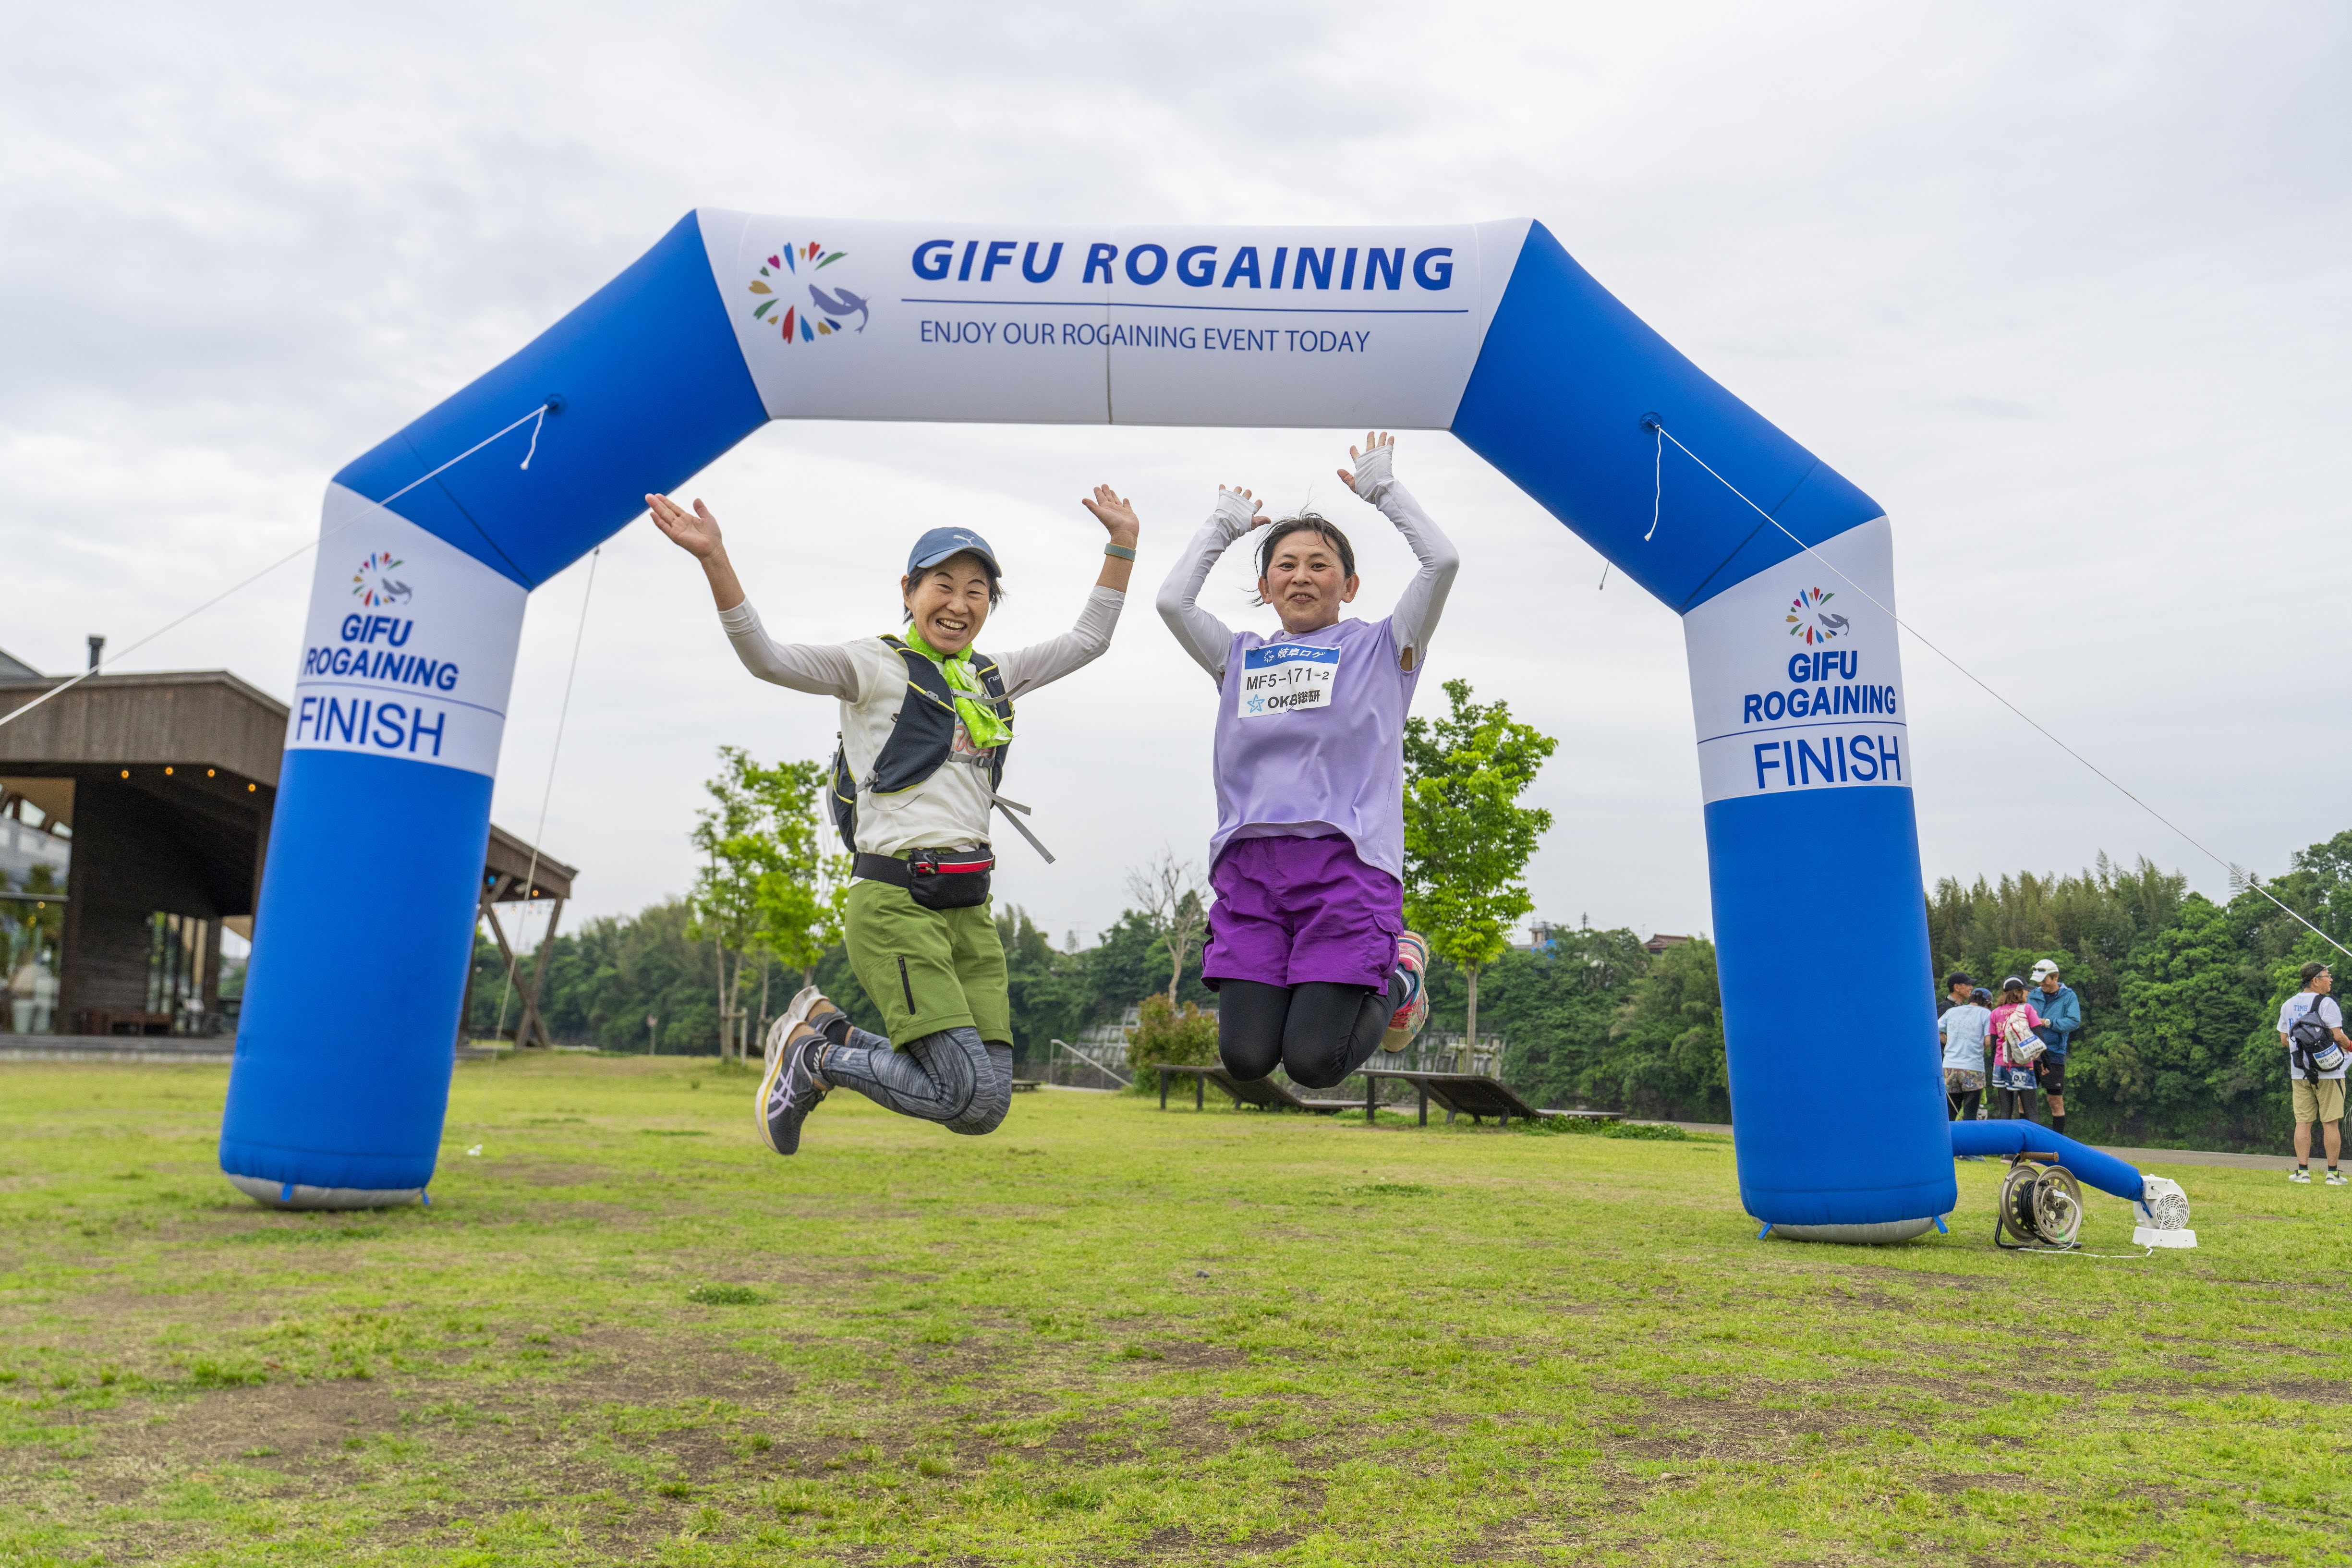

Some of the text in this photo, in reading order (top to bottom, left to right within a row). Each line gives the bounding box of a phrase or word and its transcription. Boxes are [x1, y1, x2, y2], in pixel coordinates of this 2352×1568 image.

[911, 239, 1454, 291] GIFU ROGAINING
[921, 320, 1370, 352] ENJOY OUR ROGAINING EVENT TODAY
[340, 613, 413, 647] GIFU
[303, 647, 459, 691] ROGAINING
[1277, 647, 1326, 659] 岐阜ロゲ
[1788, 650, 1858, 683] GIFU
[1743, 685, 1896, 724] ROGAINING
[296, 696, 446, 757] FINISH
[1754, 734, 1902, 789] FINISH
